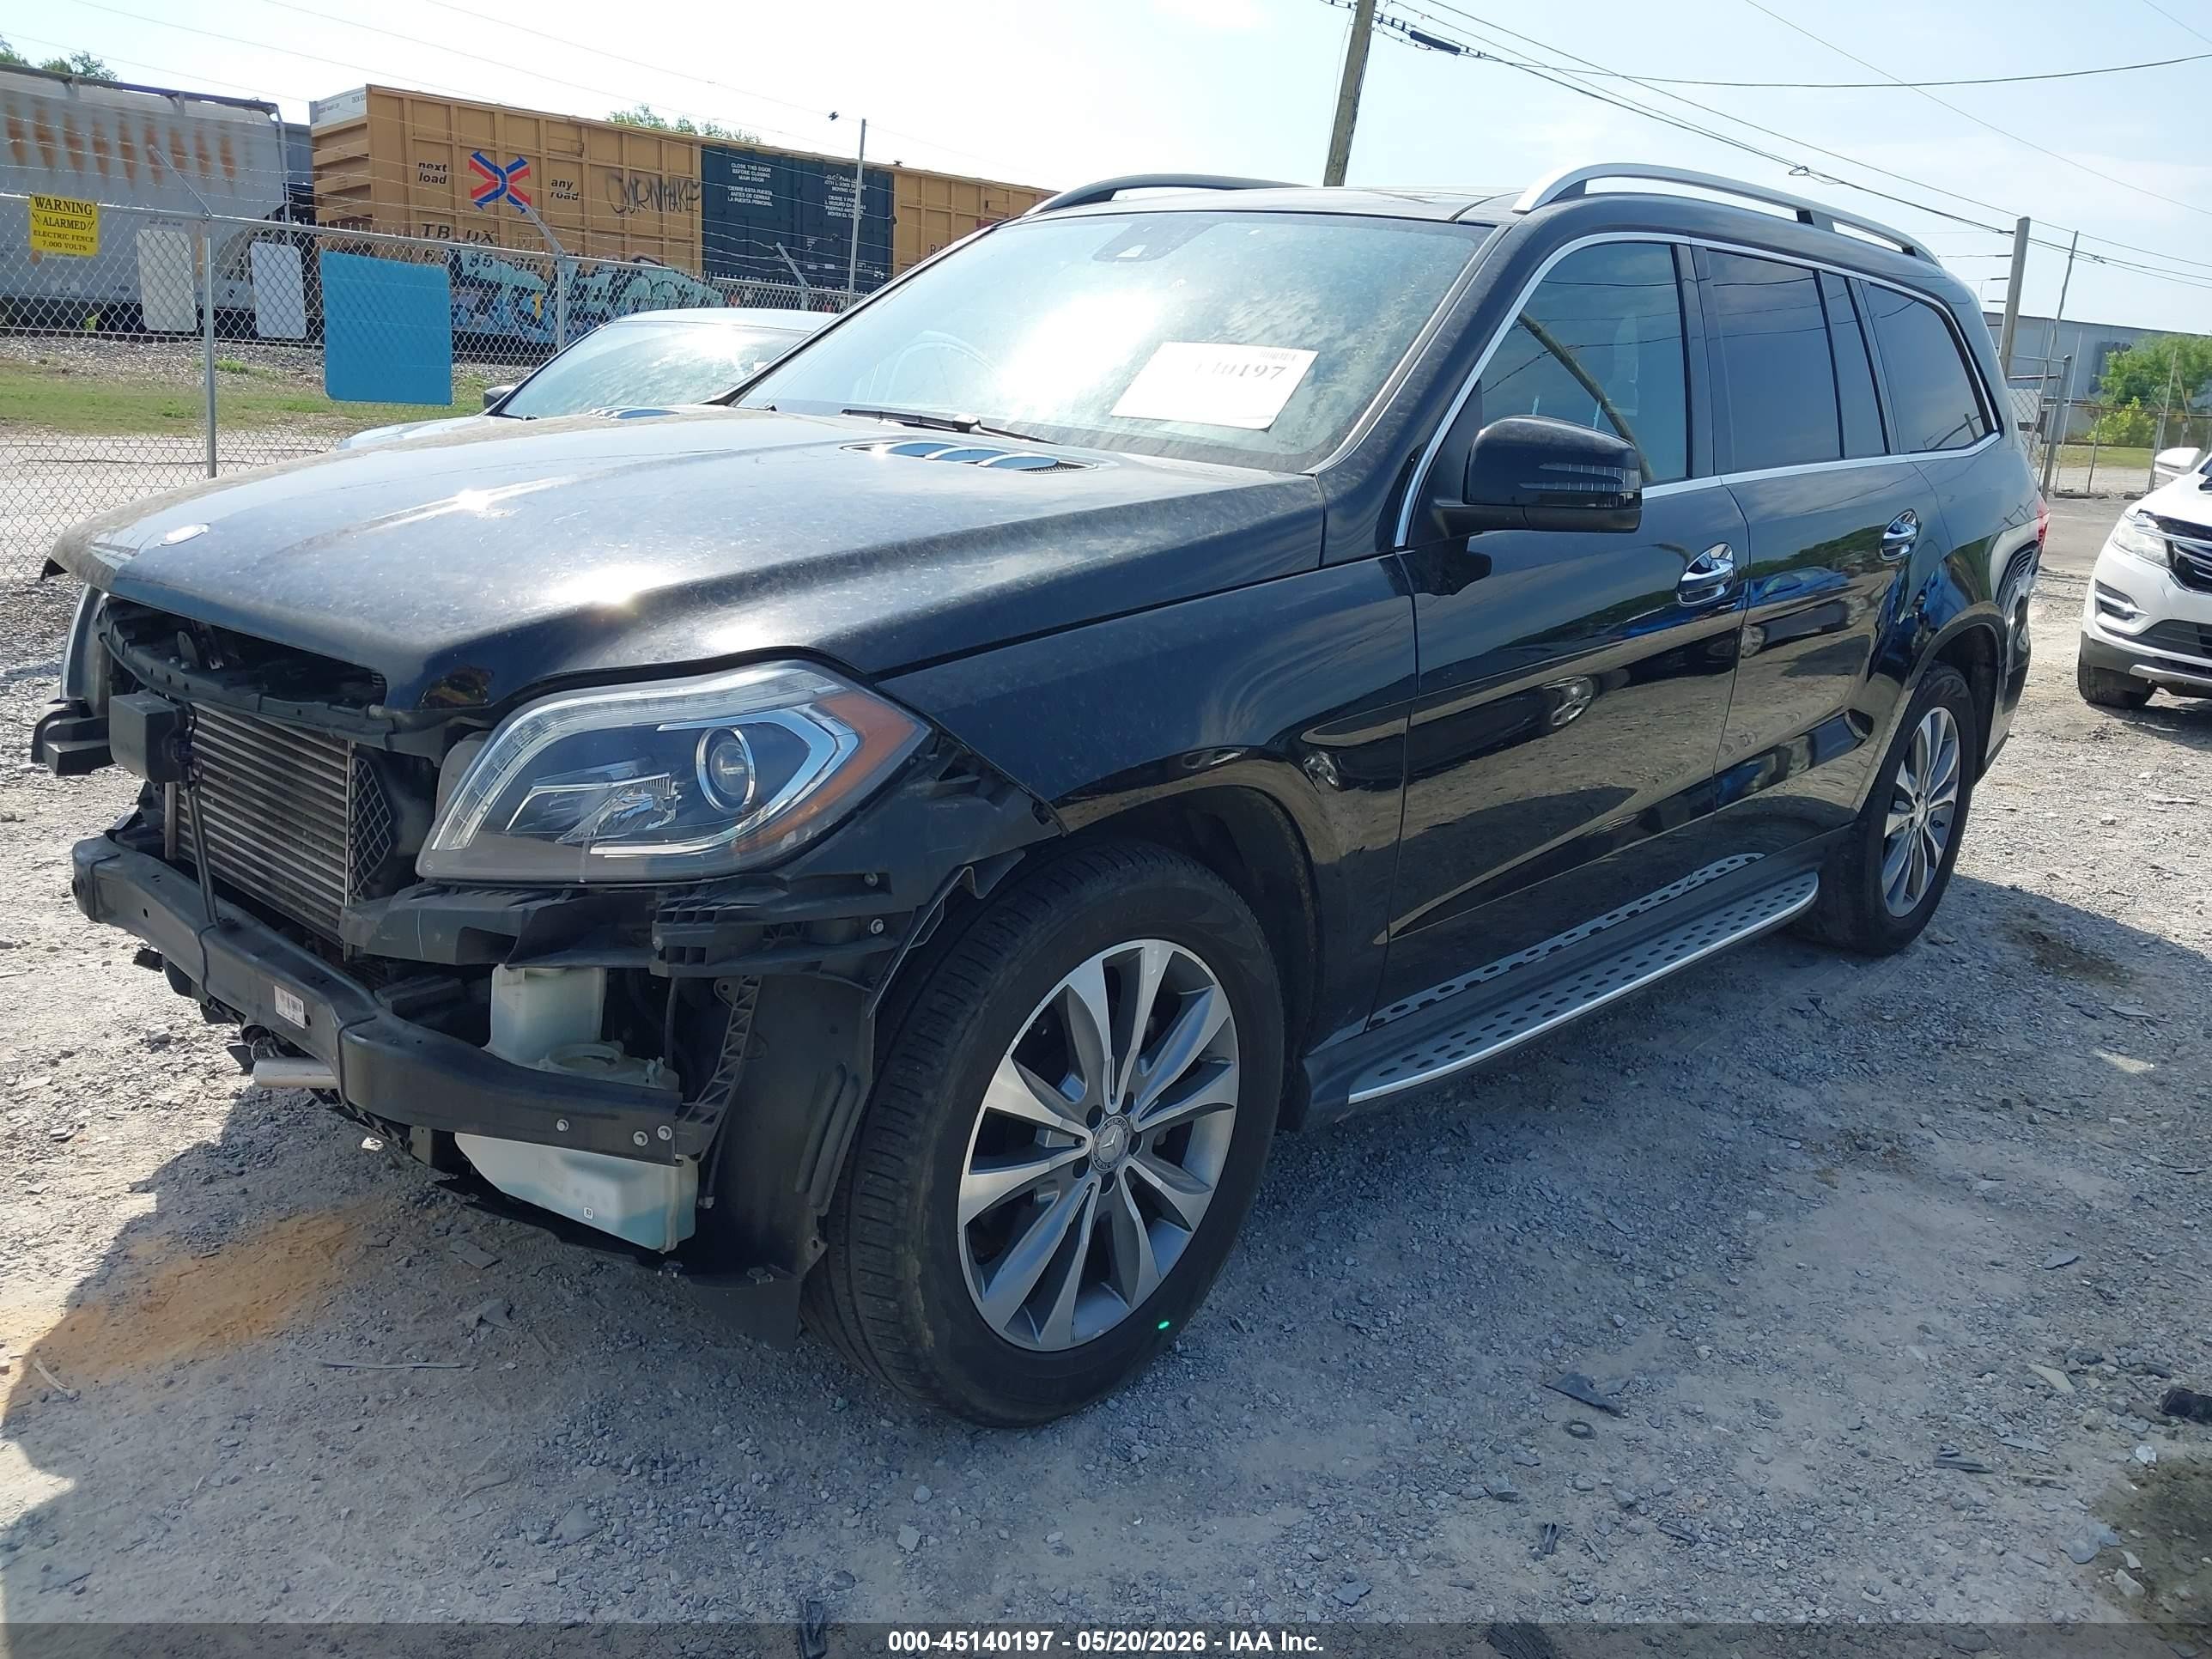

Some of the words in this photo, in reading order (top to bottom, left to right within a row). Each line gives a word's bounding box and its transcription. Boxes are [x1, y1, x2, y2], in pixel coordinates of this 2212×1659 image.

[419, 162, 447, 172] next
[419, 172, 447, 185] load
[550, 179, 574, 191] any
[550, 191, 579, 200] road
[34, 197, 93, 216] WARNING
[43, 216, 87, 230] ALARMED
[33, 229, 70, 240] ELECTRIC
[71, 234, 95, 243] FENCE
[64, 242, 88, 251] VOLTS
